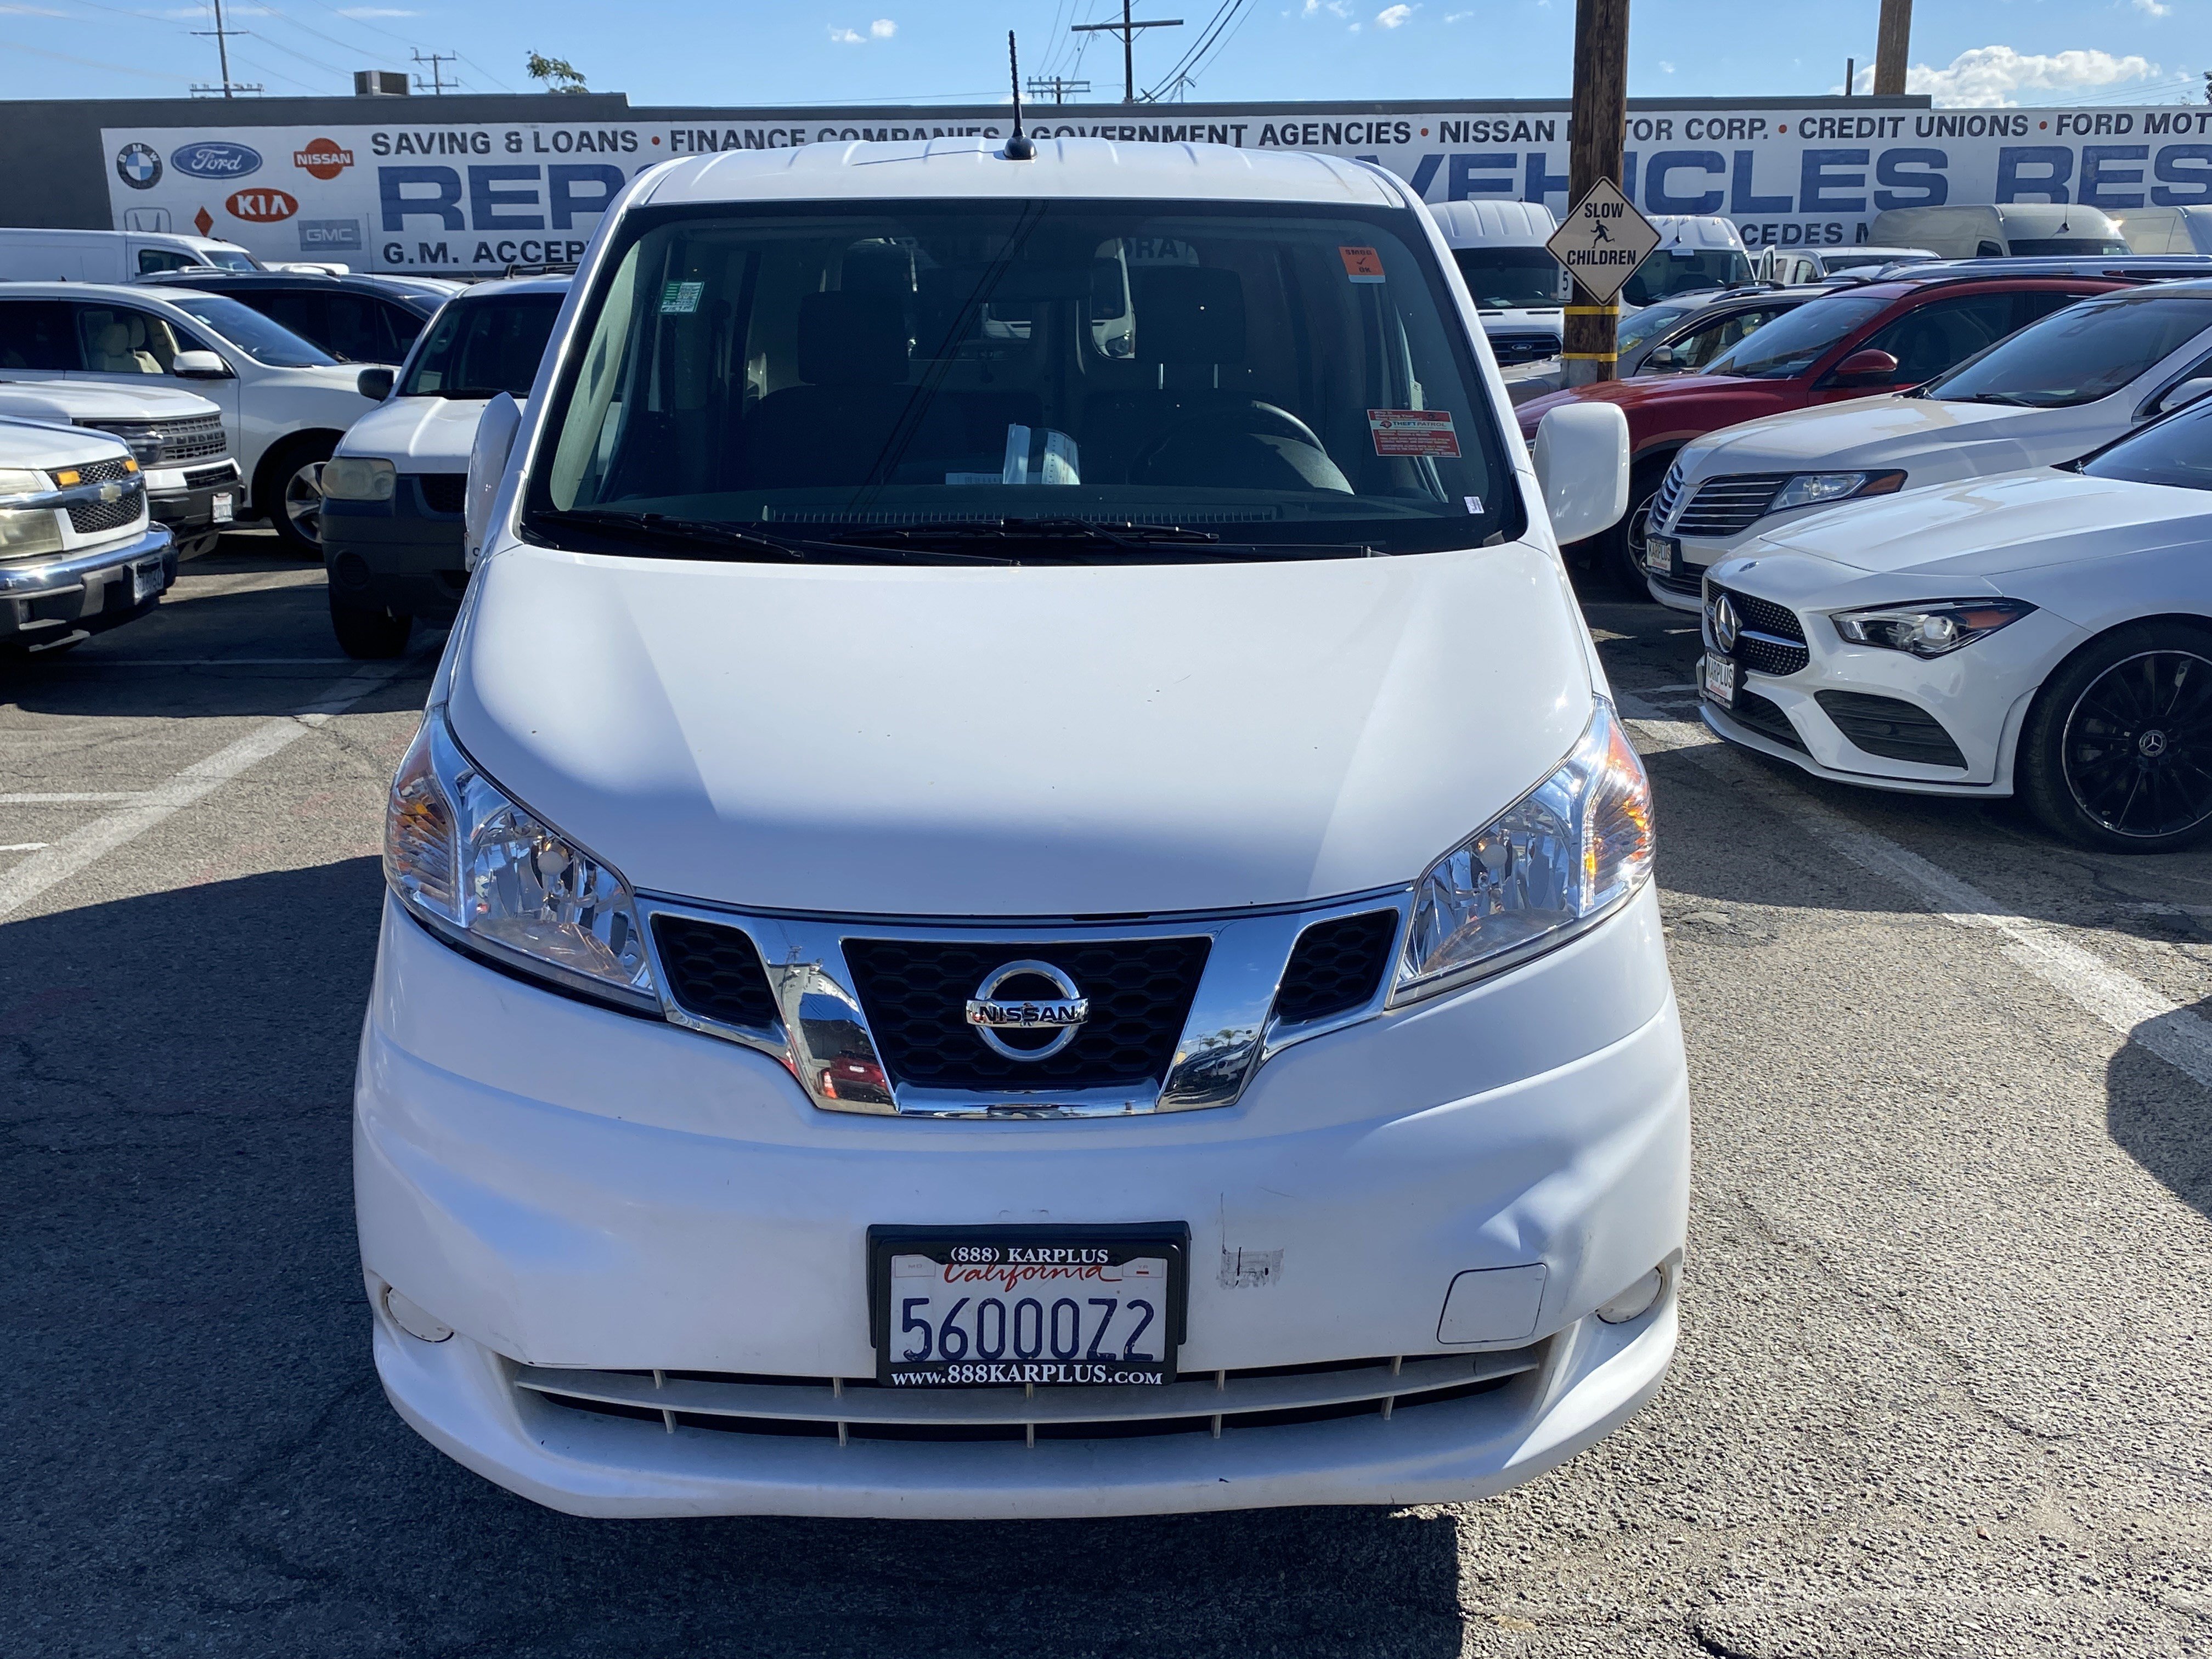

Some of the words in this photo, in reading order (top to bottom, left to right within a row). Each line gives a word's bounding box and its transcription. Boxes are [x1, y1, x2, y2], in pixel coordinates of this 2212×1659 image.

[371, 132, 490, 156] SAVING
[505, 131, 523, 153] &
[534, 129, 639, 154] LOANS
[670, 129, 805, 152] FINANCE
[1259, 121, 1411, 146] AGENCIES
[1440, 120, 1555, 143] NISSAN
[1685, 118, 1768, 140] CORP.
[1799, 116, 1905, 139] CREDIT
[1916, 115, 2029, 138] UNIONS
[2056, 113, 2134, 136] FORD
[2143, 112, 2212, 134] MOT
[119, 144, 160, 163] BMW
[191, 149, 242, 171] Ford
[297, 153, 351, 165] NISSAN
[236, 195, 289, 215] KIA
[378, 164, 656, 231] REP
[1584, 202, 1624, 219] SLOW
[306, 228, 354, 241] GMC
[383, 241, 458, 264] G.M.
[473, 240, 590, 263] ACCEP
[1567, 250, 1637, 266] CHILDREN
[980, 1005, 1075, 1023] NISSAN
[950, 1247, 1000, 1262] (888)
[1007, 1248, 1109, 1263] KARPLUS
[944, 1263, 1123, 1293] California
[902, 1297, 1155, 1361] 56000Z2
